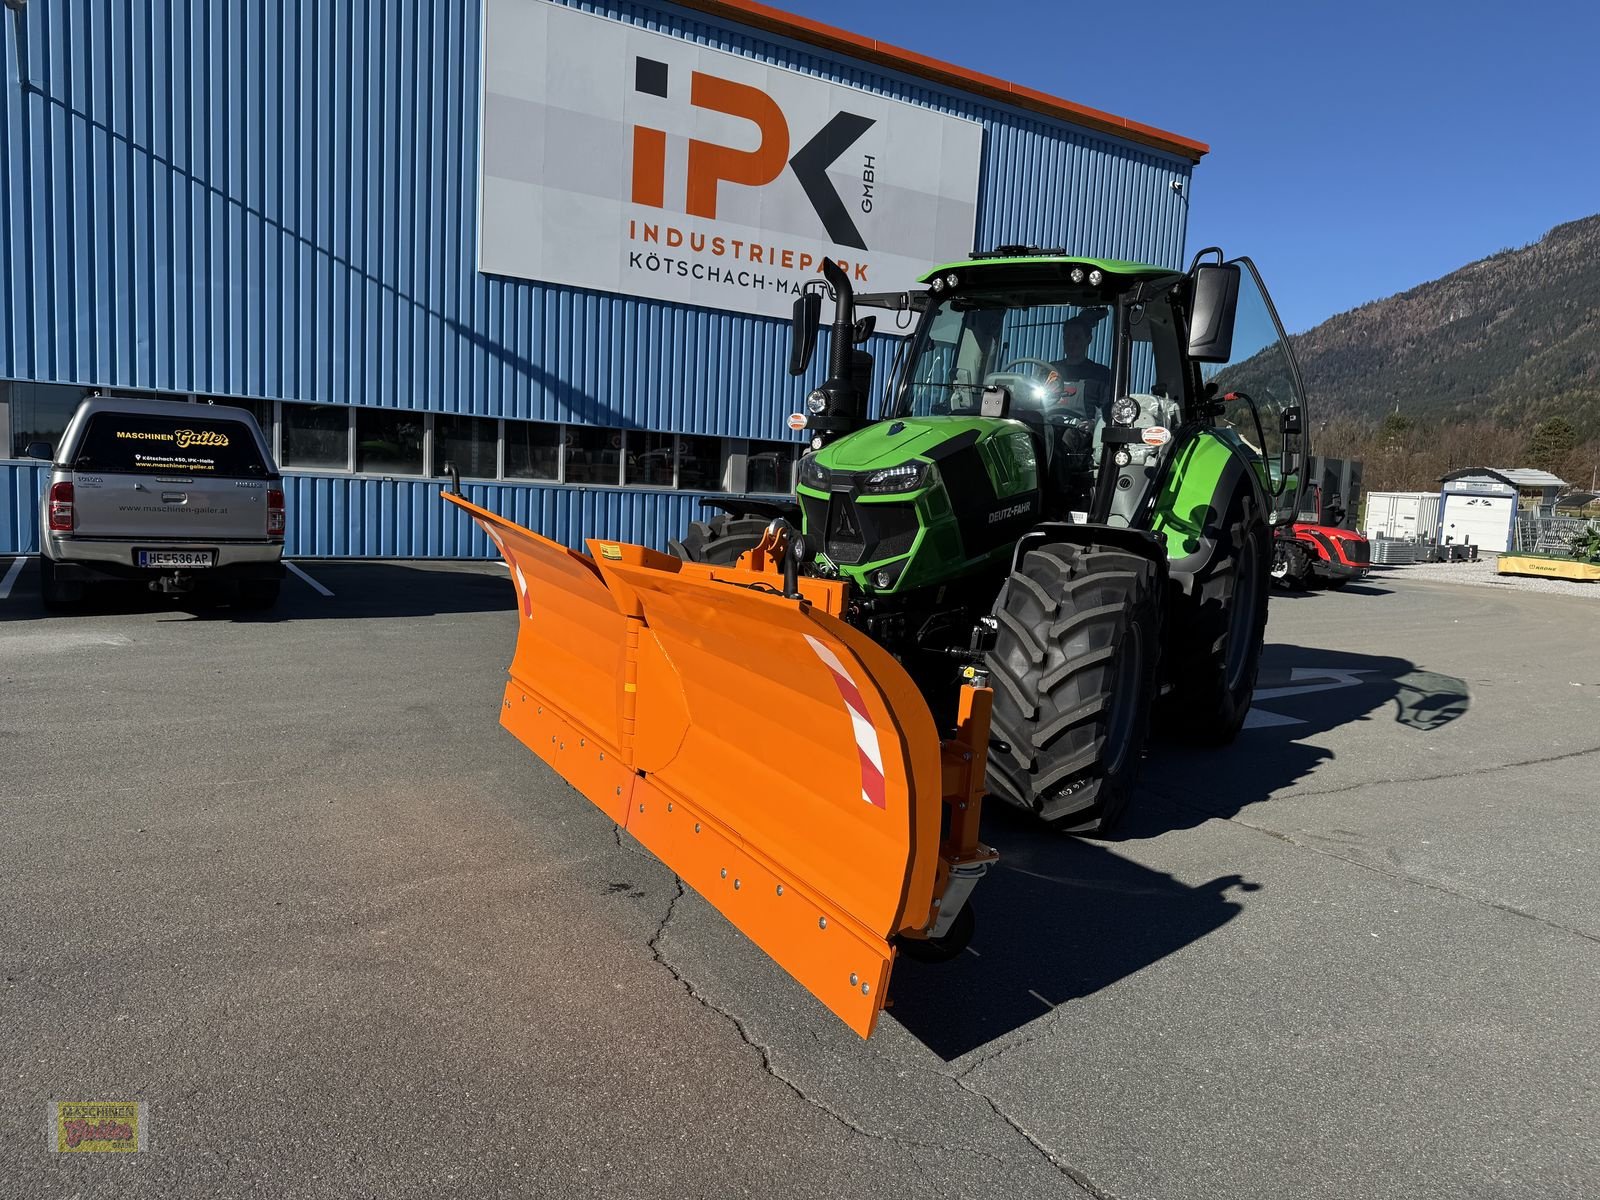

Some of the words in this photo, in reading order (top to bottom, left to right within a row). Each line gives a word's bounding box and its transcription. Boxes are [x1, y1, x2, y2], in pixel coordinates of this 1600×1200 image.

[861, 154, 876, 214] GMBH
[116, 431, 174, 441] MASCHINEN
[174, 429, 229, 448] Gailer
[135, 461, 215, 470] www.maschinen-gailer.at
[118, 505, 228, 515] www.maschinen-gailer.at
[989, 502, 1031, 523] DEUTZ-FAHR
